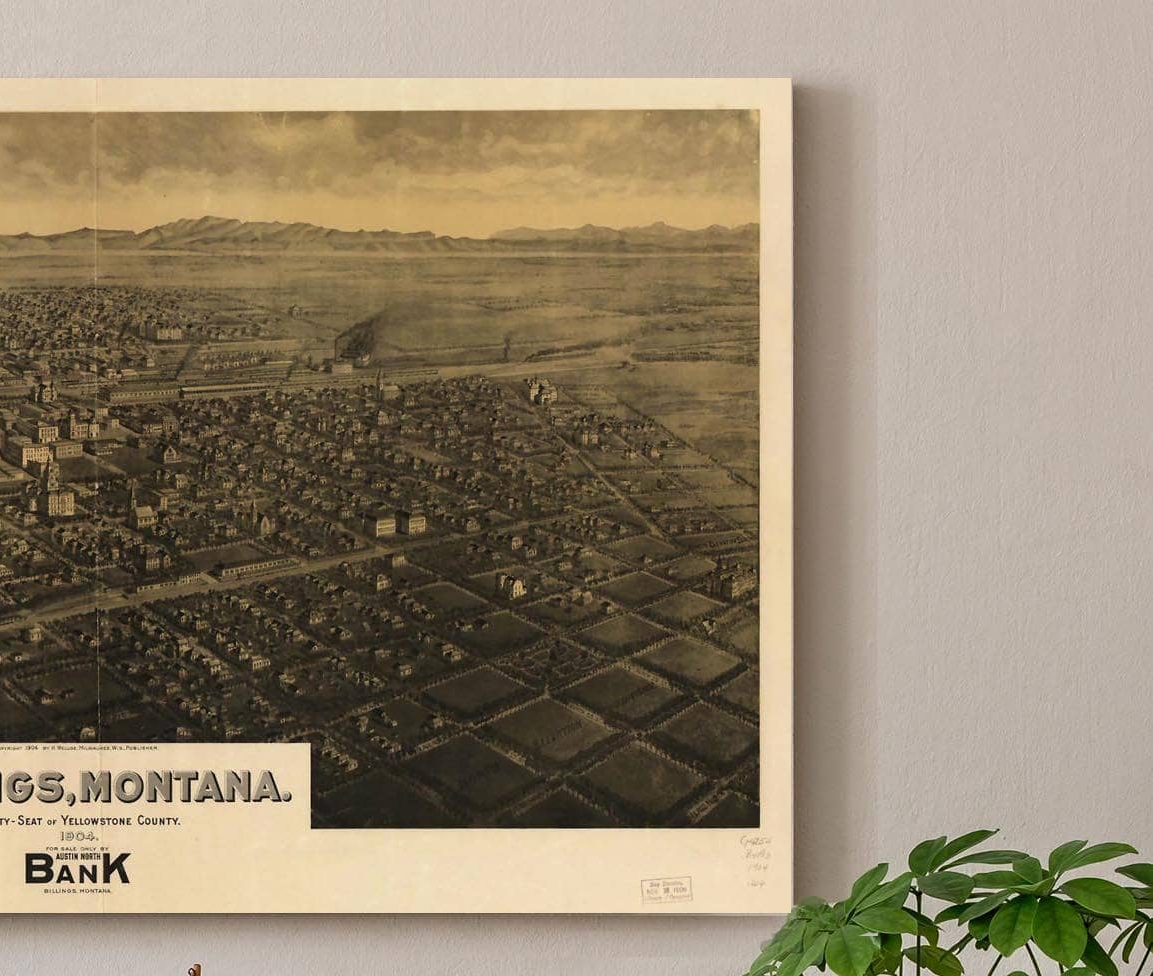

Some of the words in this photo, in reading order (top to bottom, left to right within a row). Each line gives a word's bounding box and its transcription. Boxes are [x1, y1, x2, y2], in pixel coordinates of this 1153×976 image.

[80, 770, 293, 804] MONTANA.
[56, 853, 79, 861] AUSTIN
[80, 853, 101, 861] NORTH
